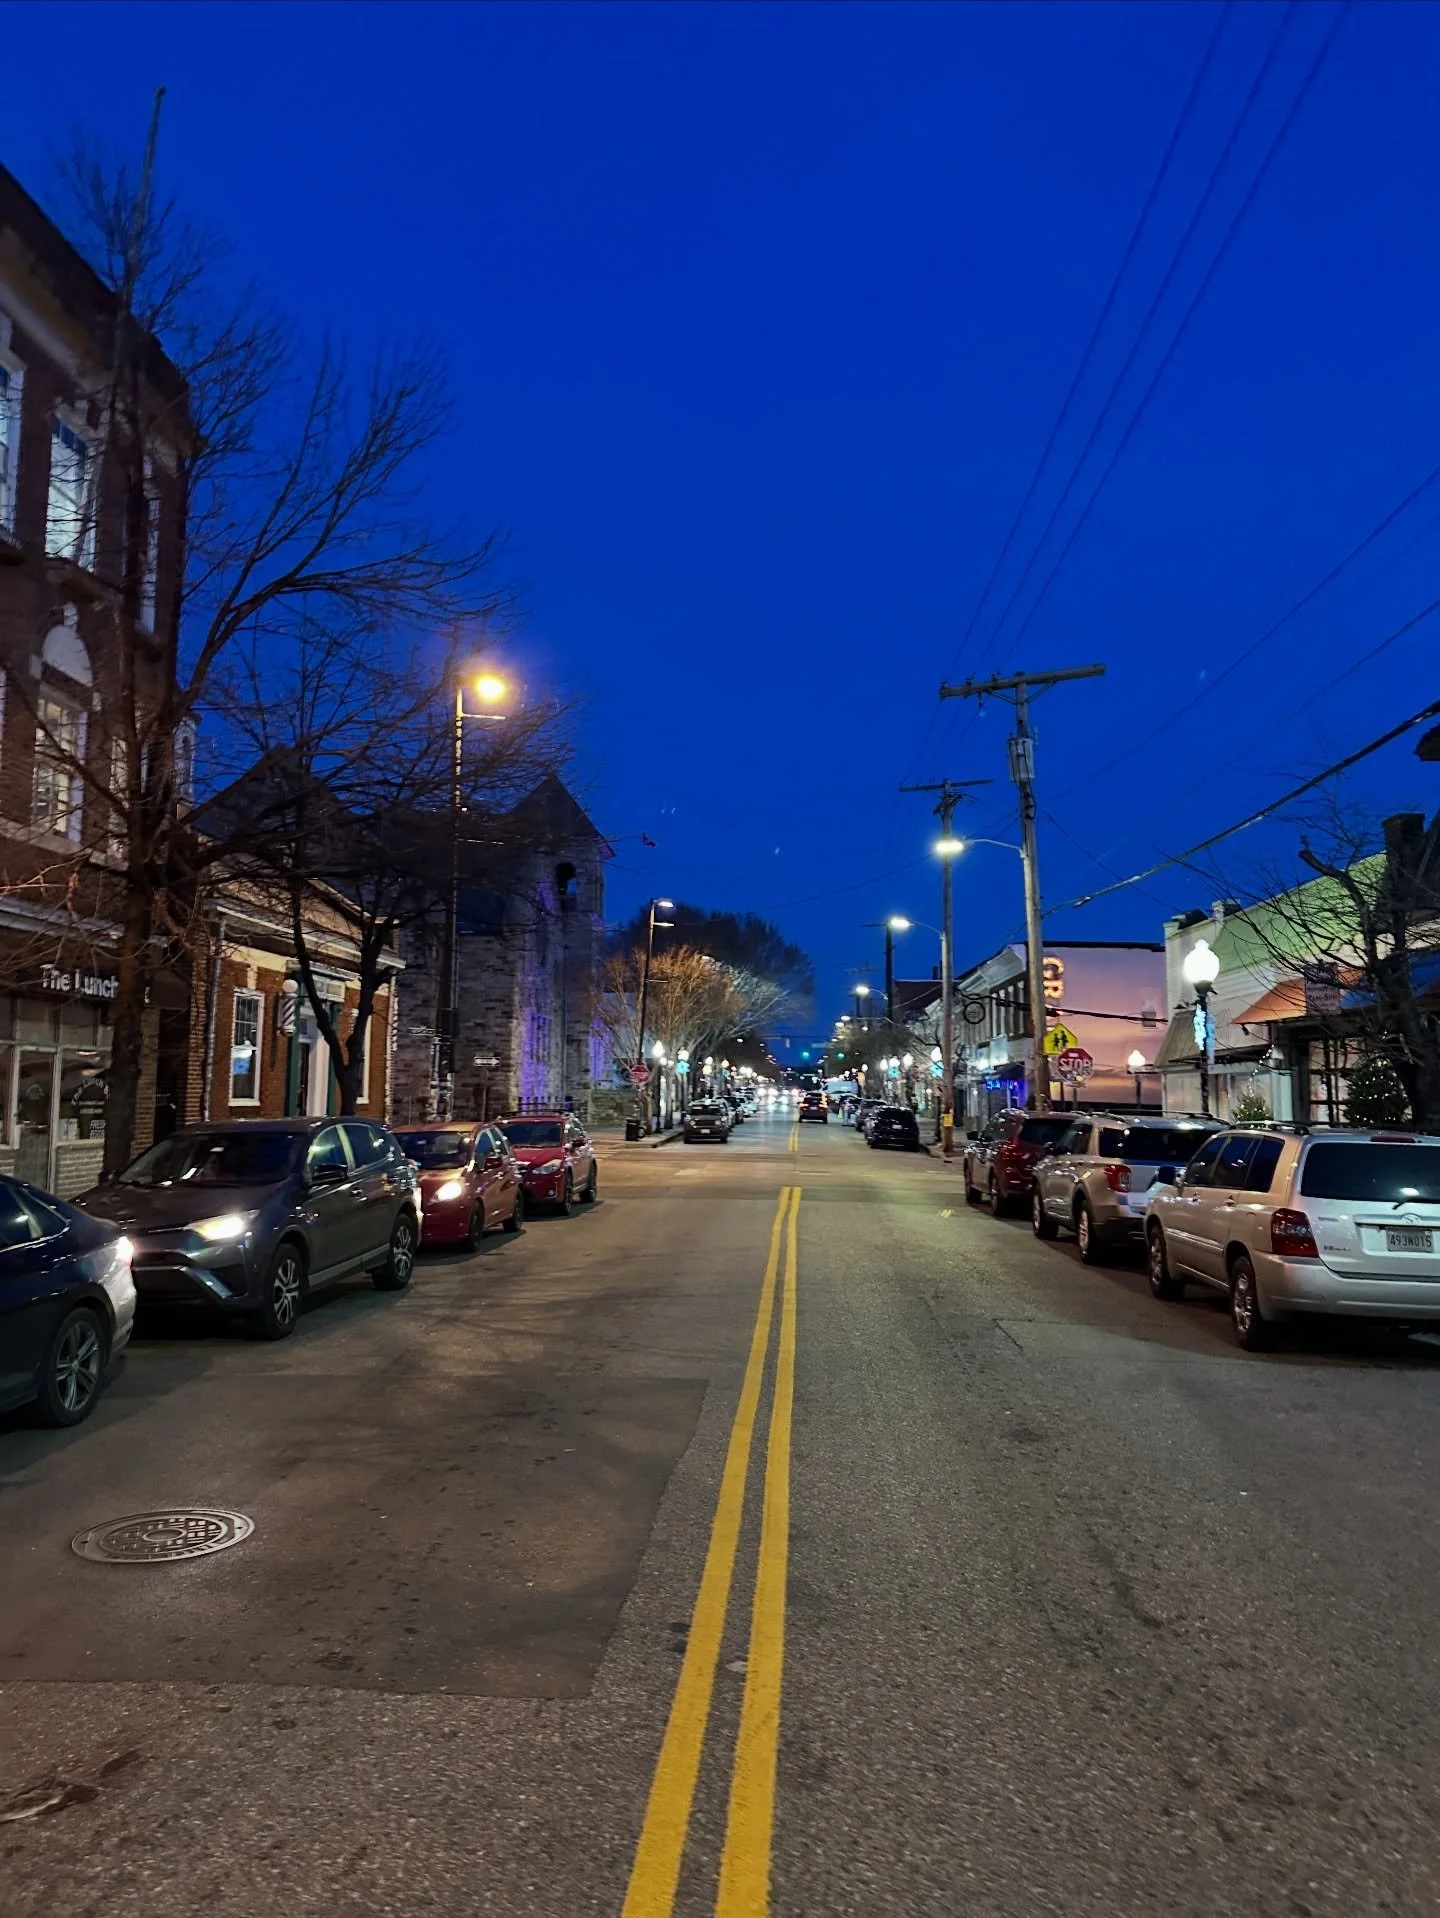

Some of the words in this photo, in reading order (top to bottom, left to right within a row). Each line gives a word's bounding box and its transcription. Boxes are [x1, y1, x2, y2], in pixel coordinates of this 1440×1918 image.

[39, 963, 72, 992] The
[1058, 1058, 1092, 1072] STOP
[82, 1077, 104, 1089] Lunch
